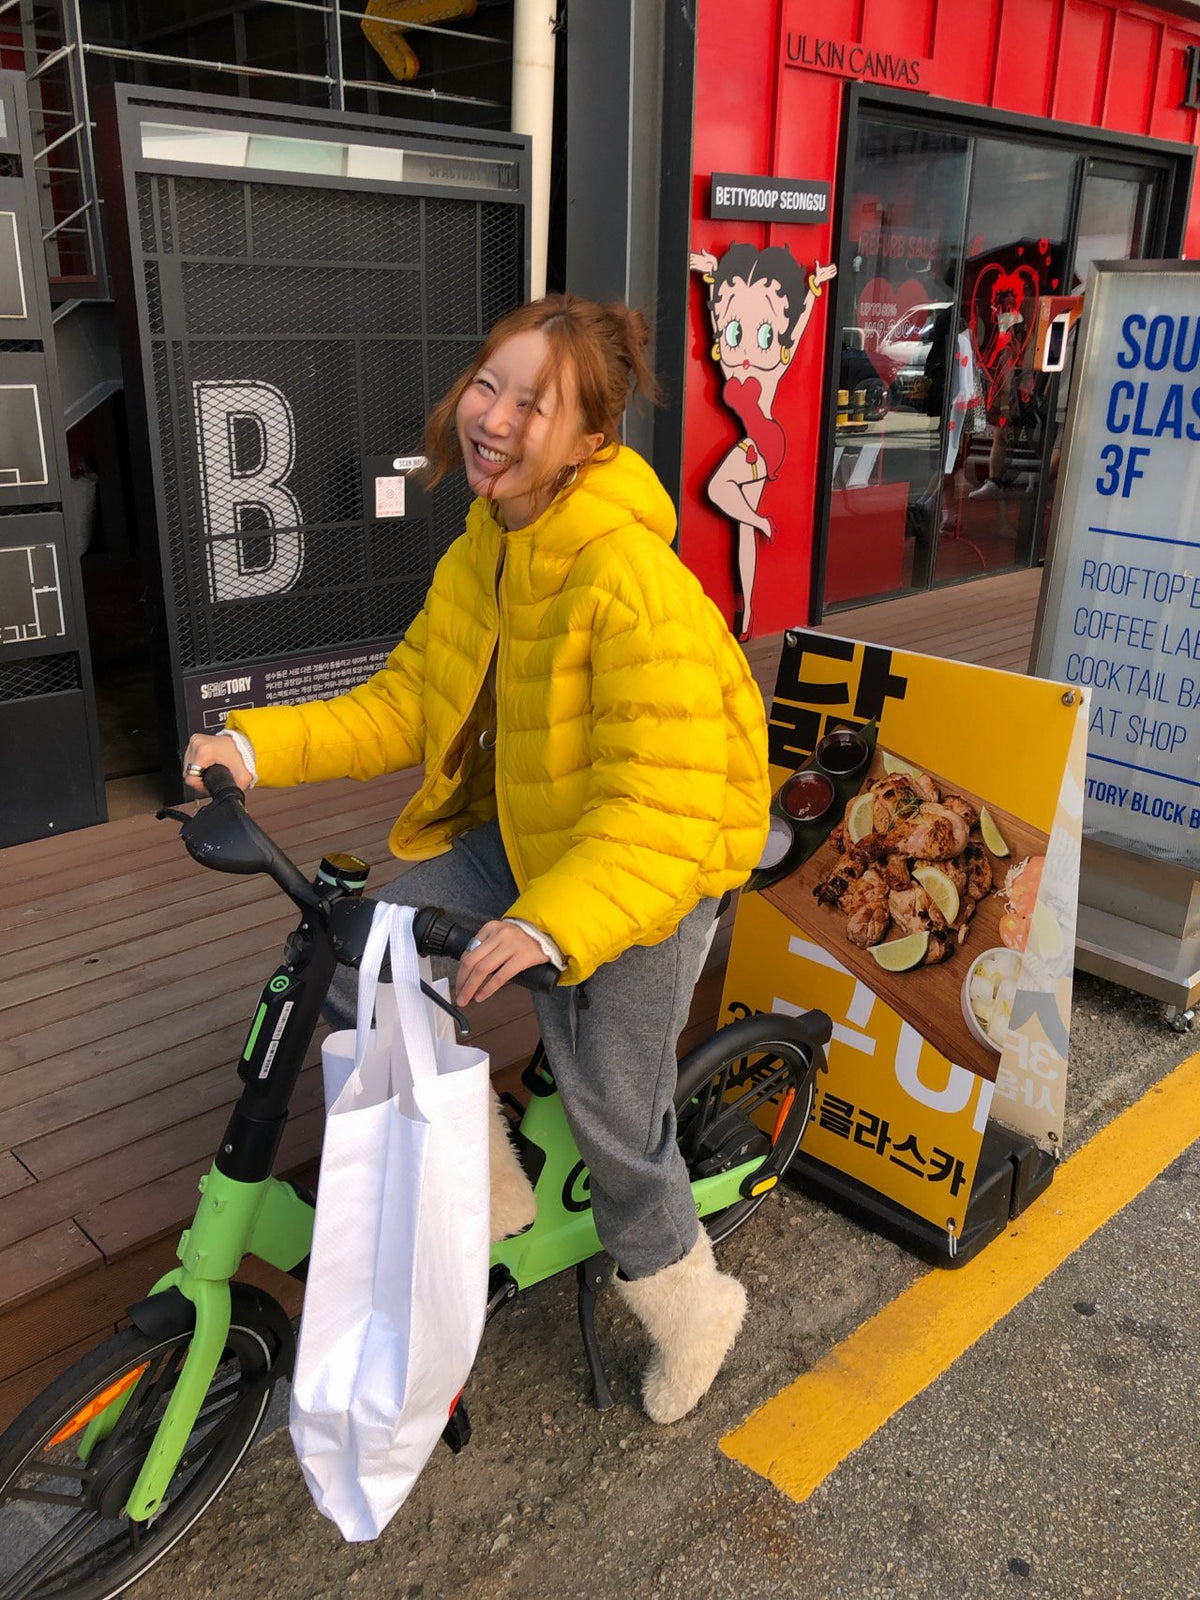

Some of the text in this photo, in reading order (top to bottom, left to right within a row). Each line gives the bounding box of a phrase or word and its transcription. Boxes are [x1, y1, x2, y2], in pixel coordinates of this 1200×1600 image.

[787, 32, 920, 86] ULKIN CANVAS
[715, 186, 826, 212] BETTYBOOP SEONGSU
[907, 235, 937, 260] SALE
[1116, 313, 1200, 373] SOU
[193, 379, 304, 604] B
[1096, 443, 1151, 499] 3F
[1080, 559, 1186, 604] ROOFTOP
[1073, 607, 1158, 651] COFFEE
[1066, 653, 1169, 703] COCKTAIL
[1088, 706, 1187, 753] AT SHOP
[1085, 778, 1129, 808] TORY
[1131, 791, 1187, 826] BLOCK
[811, 1088, 967, 1198] 클라스카
